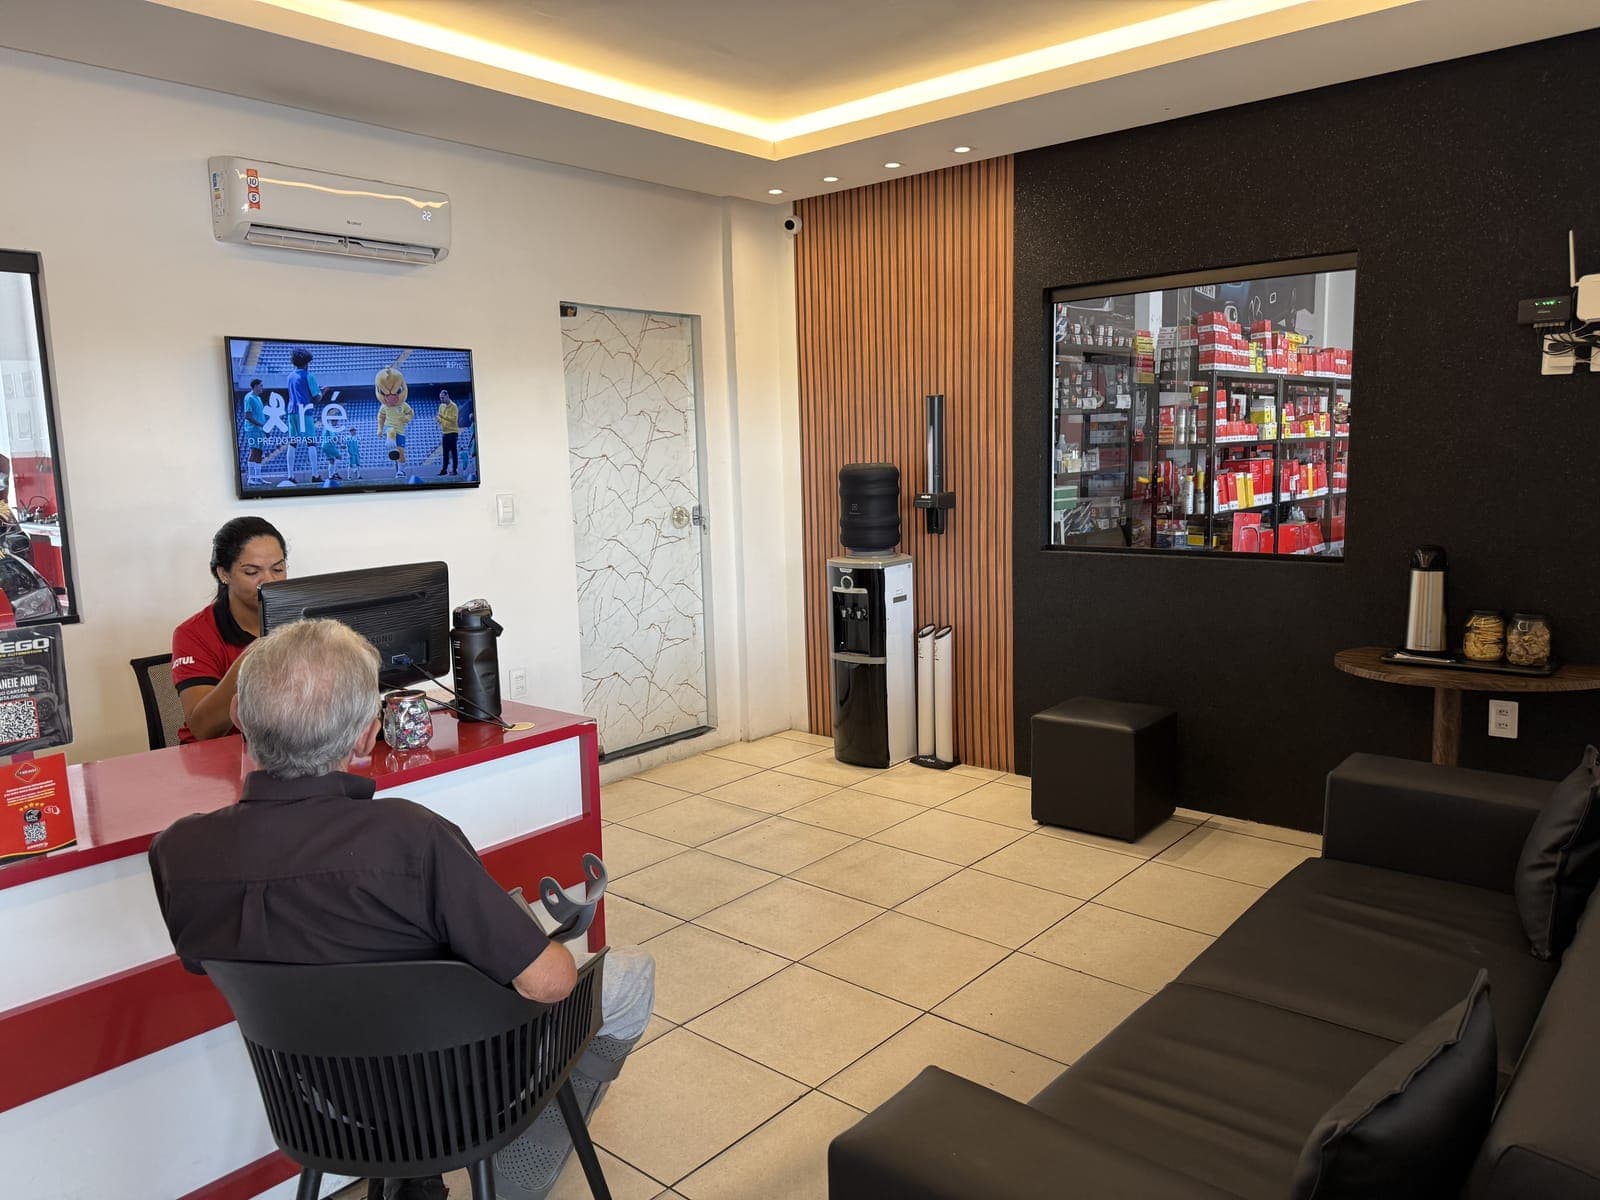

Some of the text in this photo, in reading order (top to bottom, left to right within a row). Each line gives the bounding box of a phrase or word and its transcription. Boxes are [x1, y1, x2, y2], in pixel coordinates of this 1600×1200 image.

[248, 438, 255, 446] O
[276, 437, 289, 446] DO
[290, 435, 339, 446] BRASILEIRO
[20, 674, 38, 686] AQUI
